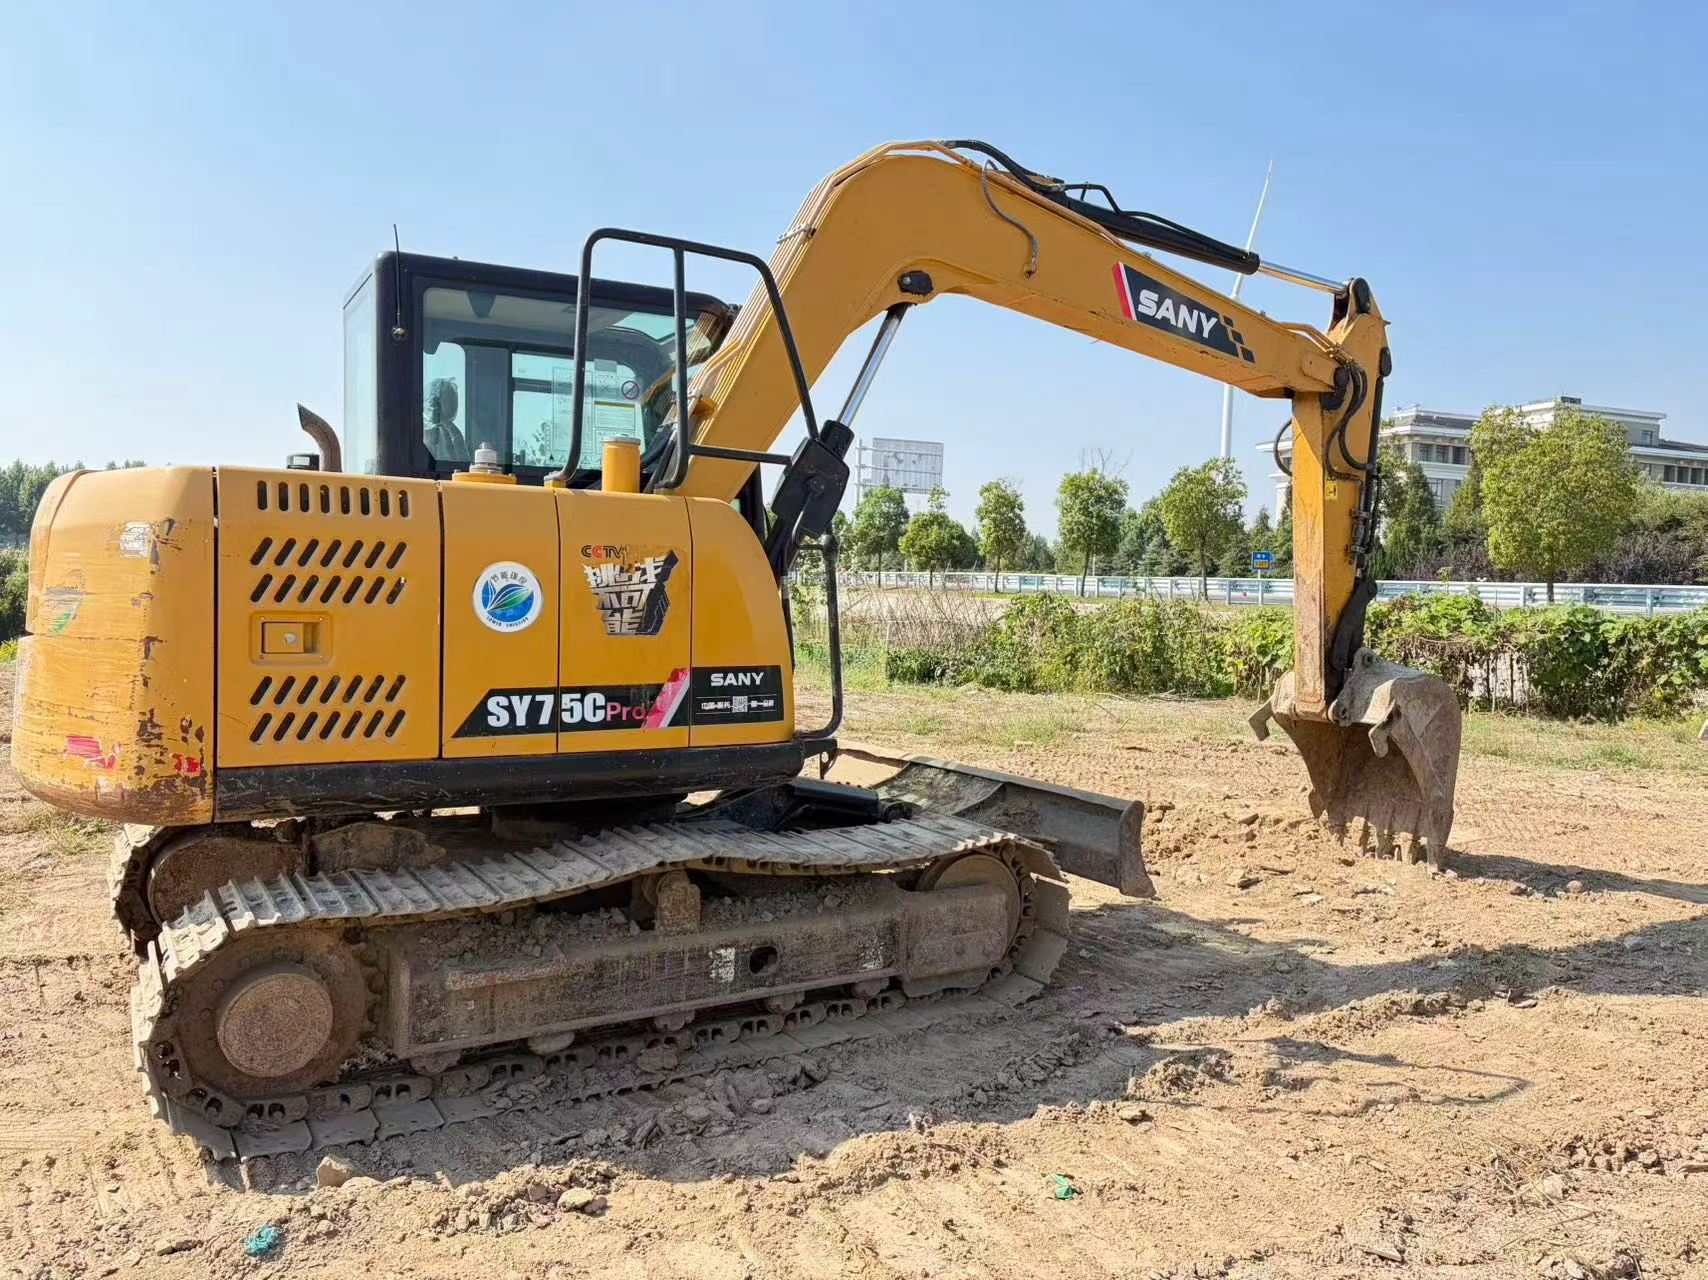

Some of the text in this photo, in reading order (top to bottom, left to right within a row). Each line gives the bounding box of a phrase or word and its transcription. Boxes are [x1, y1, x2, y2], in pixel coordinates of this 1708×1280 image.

[1137, 288, 1218, 339] SANY
[710, 672, 764, 687] SANY
[486, 692, 646, 728] SY75C Pro
